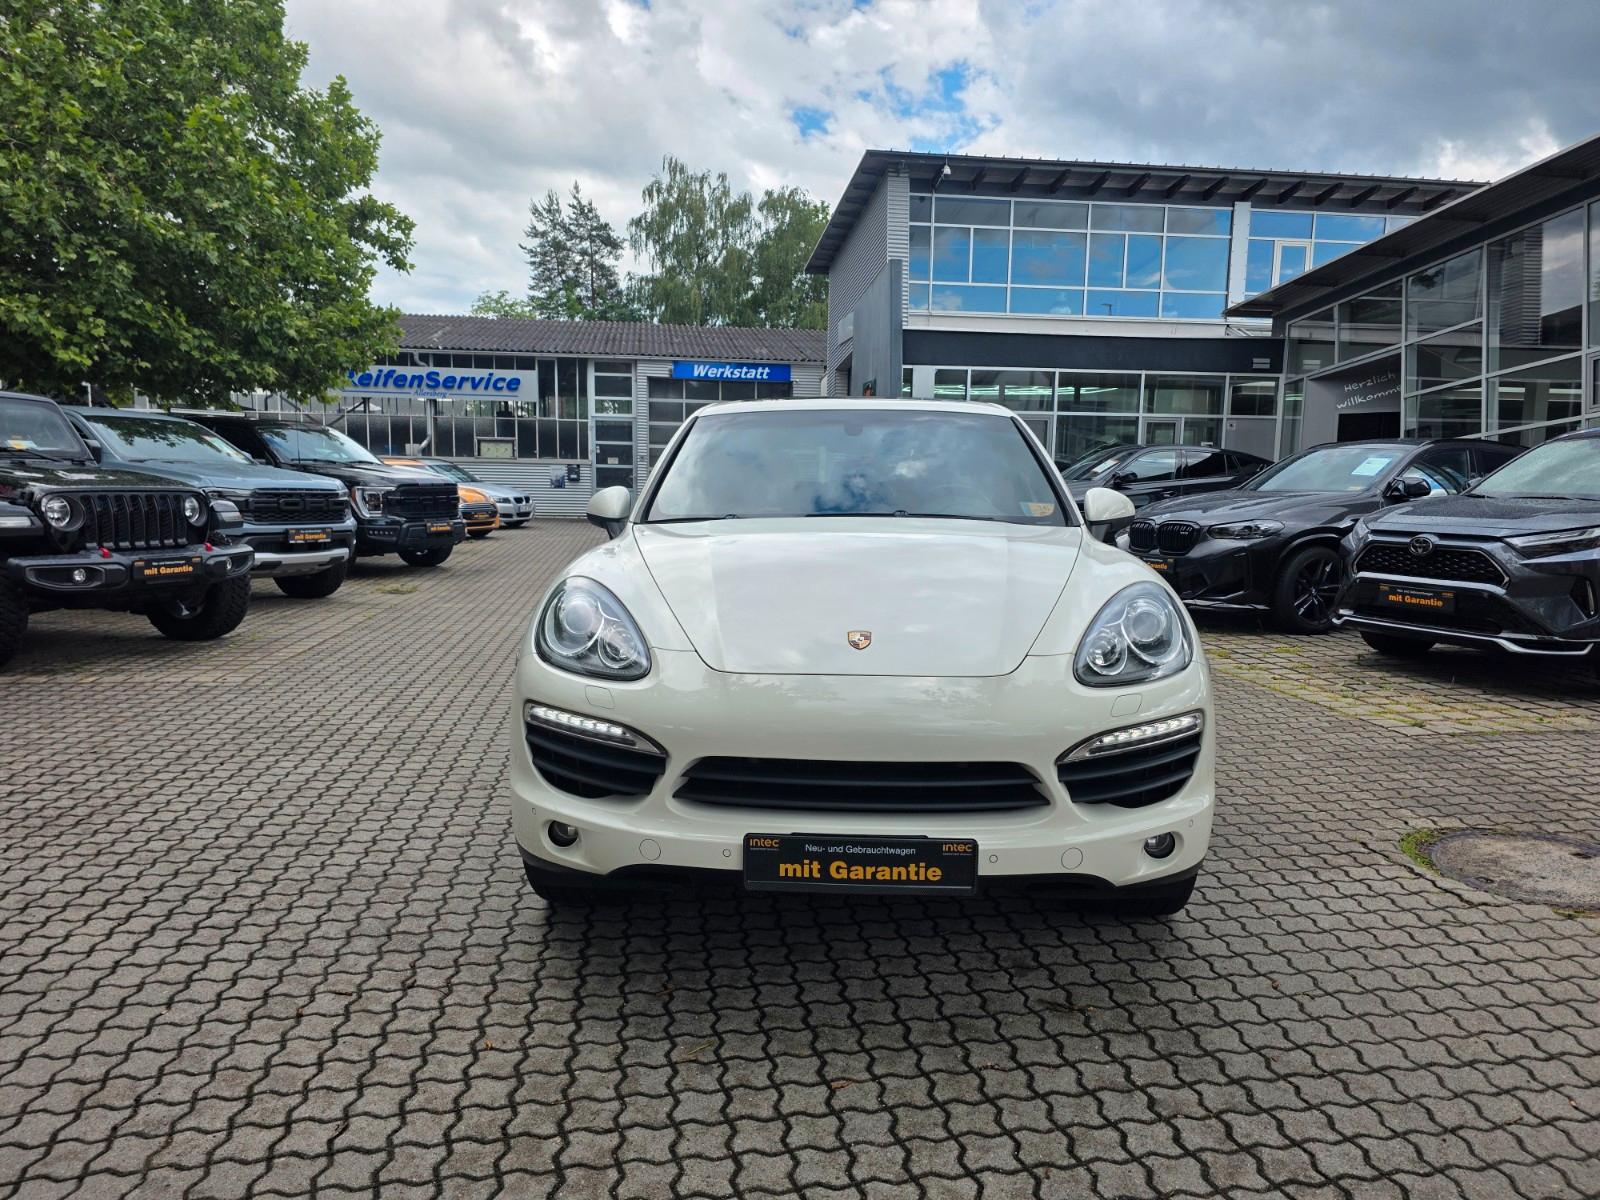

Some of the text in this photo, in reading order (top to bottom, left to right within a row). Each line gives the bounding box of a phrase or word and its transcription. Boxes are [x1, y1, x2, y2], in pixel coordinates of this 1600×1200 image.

[693, 364, 771, 379] Werkstatt
[1343, 369, 1396, 392] Herzlich
[144, 565, 194, 576] mit Garantie
[1388, 594, 1403, 602] mit
[1404, 595, 1444, 607] Garantie
[749, 838, 779, 847] intec
[942, 843, 973, 852] intec
[805, 844, 916, 856] Neu- und Gebrauchtwagen
[779, 859, 943, 881] mit Garantie
